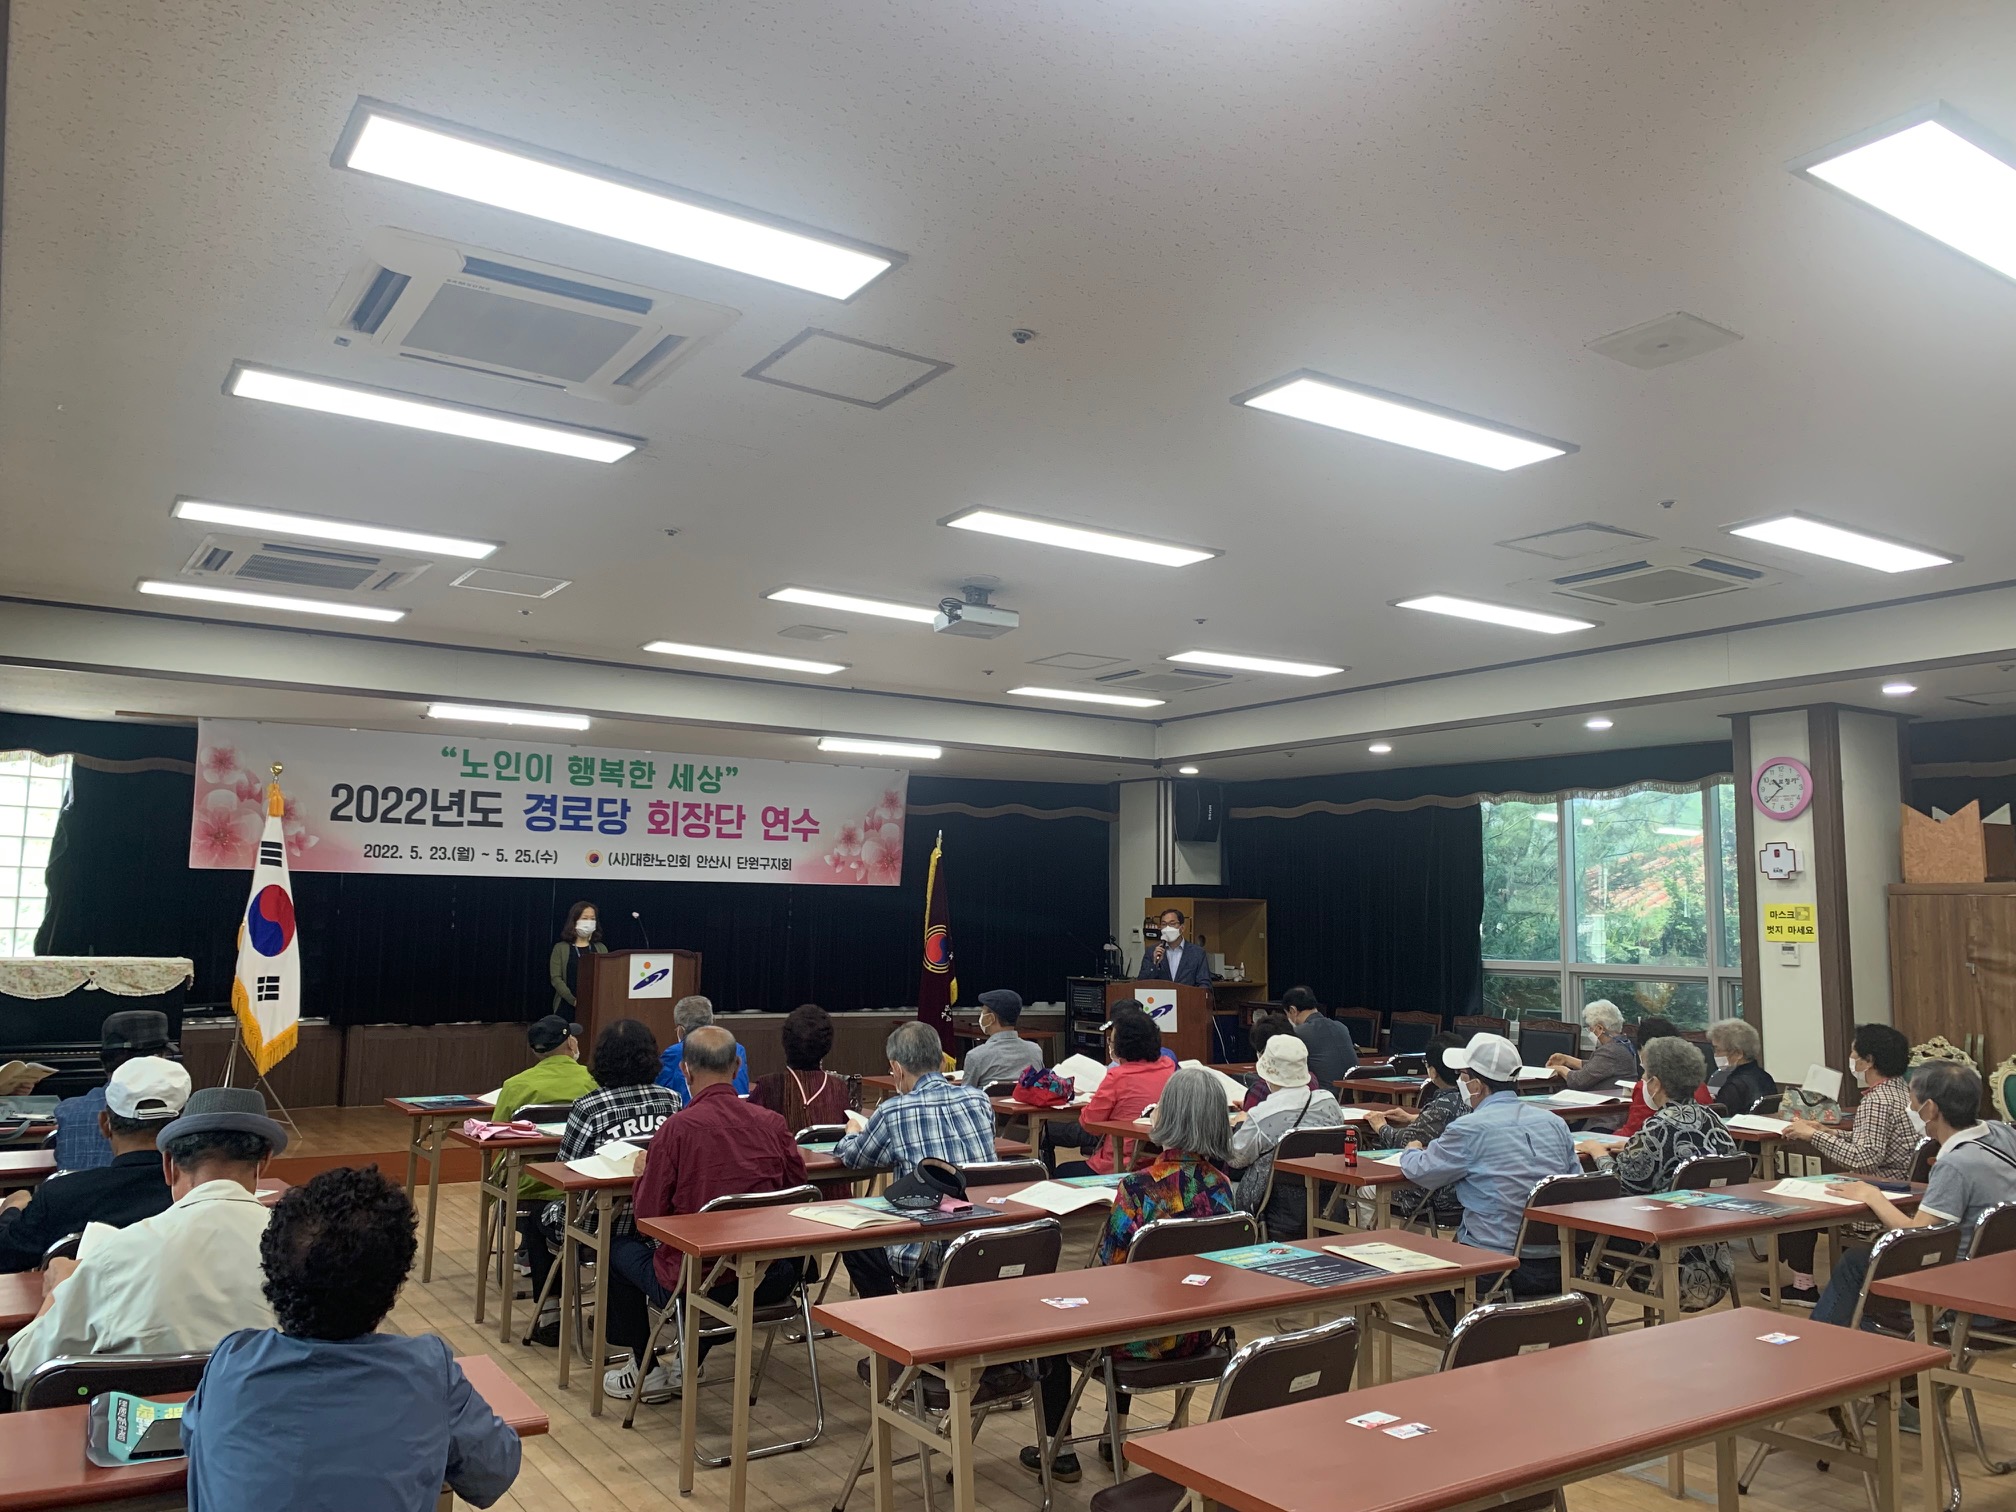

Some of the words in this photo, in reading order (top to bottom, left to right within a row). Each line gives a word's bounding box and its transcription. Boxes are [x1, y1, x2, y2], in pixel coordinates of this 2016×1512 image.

[567, 754, 656, 790] 행복한
[330, 783, 503, 828] 2022년도
[523, 793, 631, 835] 경로당
[647, 799, 746, 840] 회장단
[761, 805, 821, 843] 연수
[363, 844, 403, 860] 2022.
[410, 845, 423, 861] 5.
[496, 848, 509, 863] 5.
[515, 848, 558, 865] 25.(수)
[608, 851, 691, 869] (사)대한노인회
[696, 854, 731, 870] 안산시
[737, 855, 793, 872] 단원구지회
[1769, 910, 1795, 920] 마스크
[1766, 925, 1783, 935] 벗지
[1788, 925, 1815, 935] 마세요
